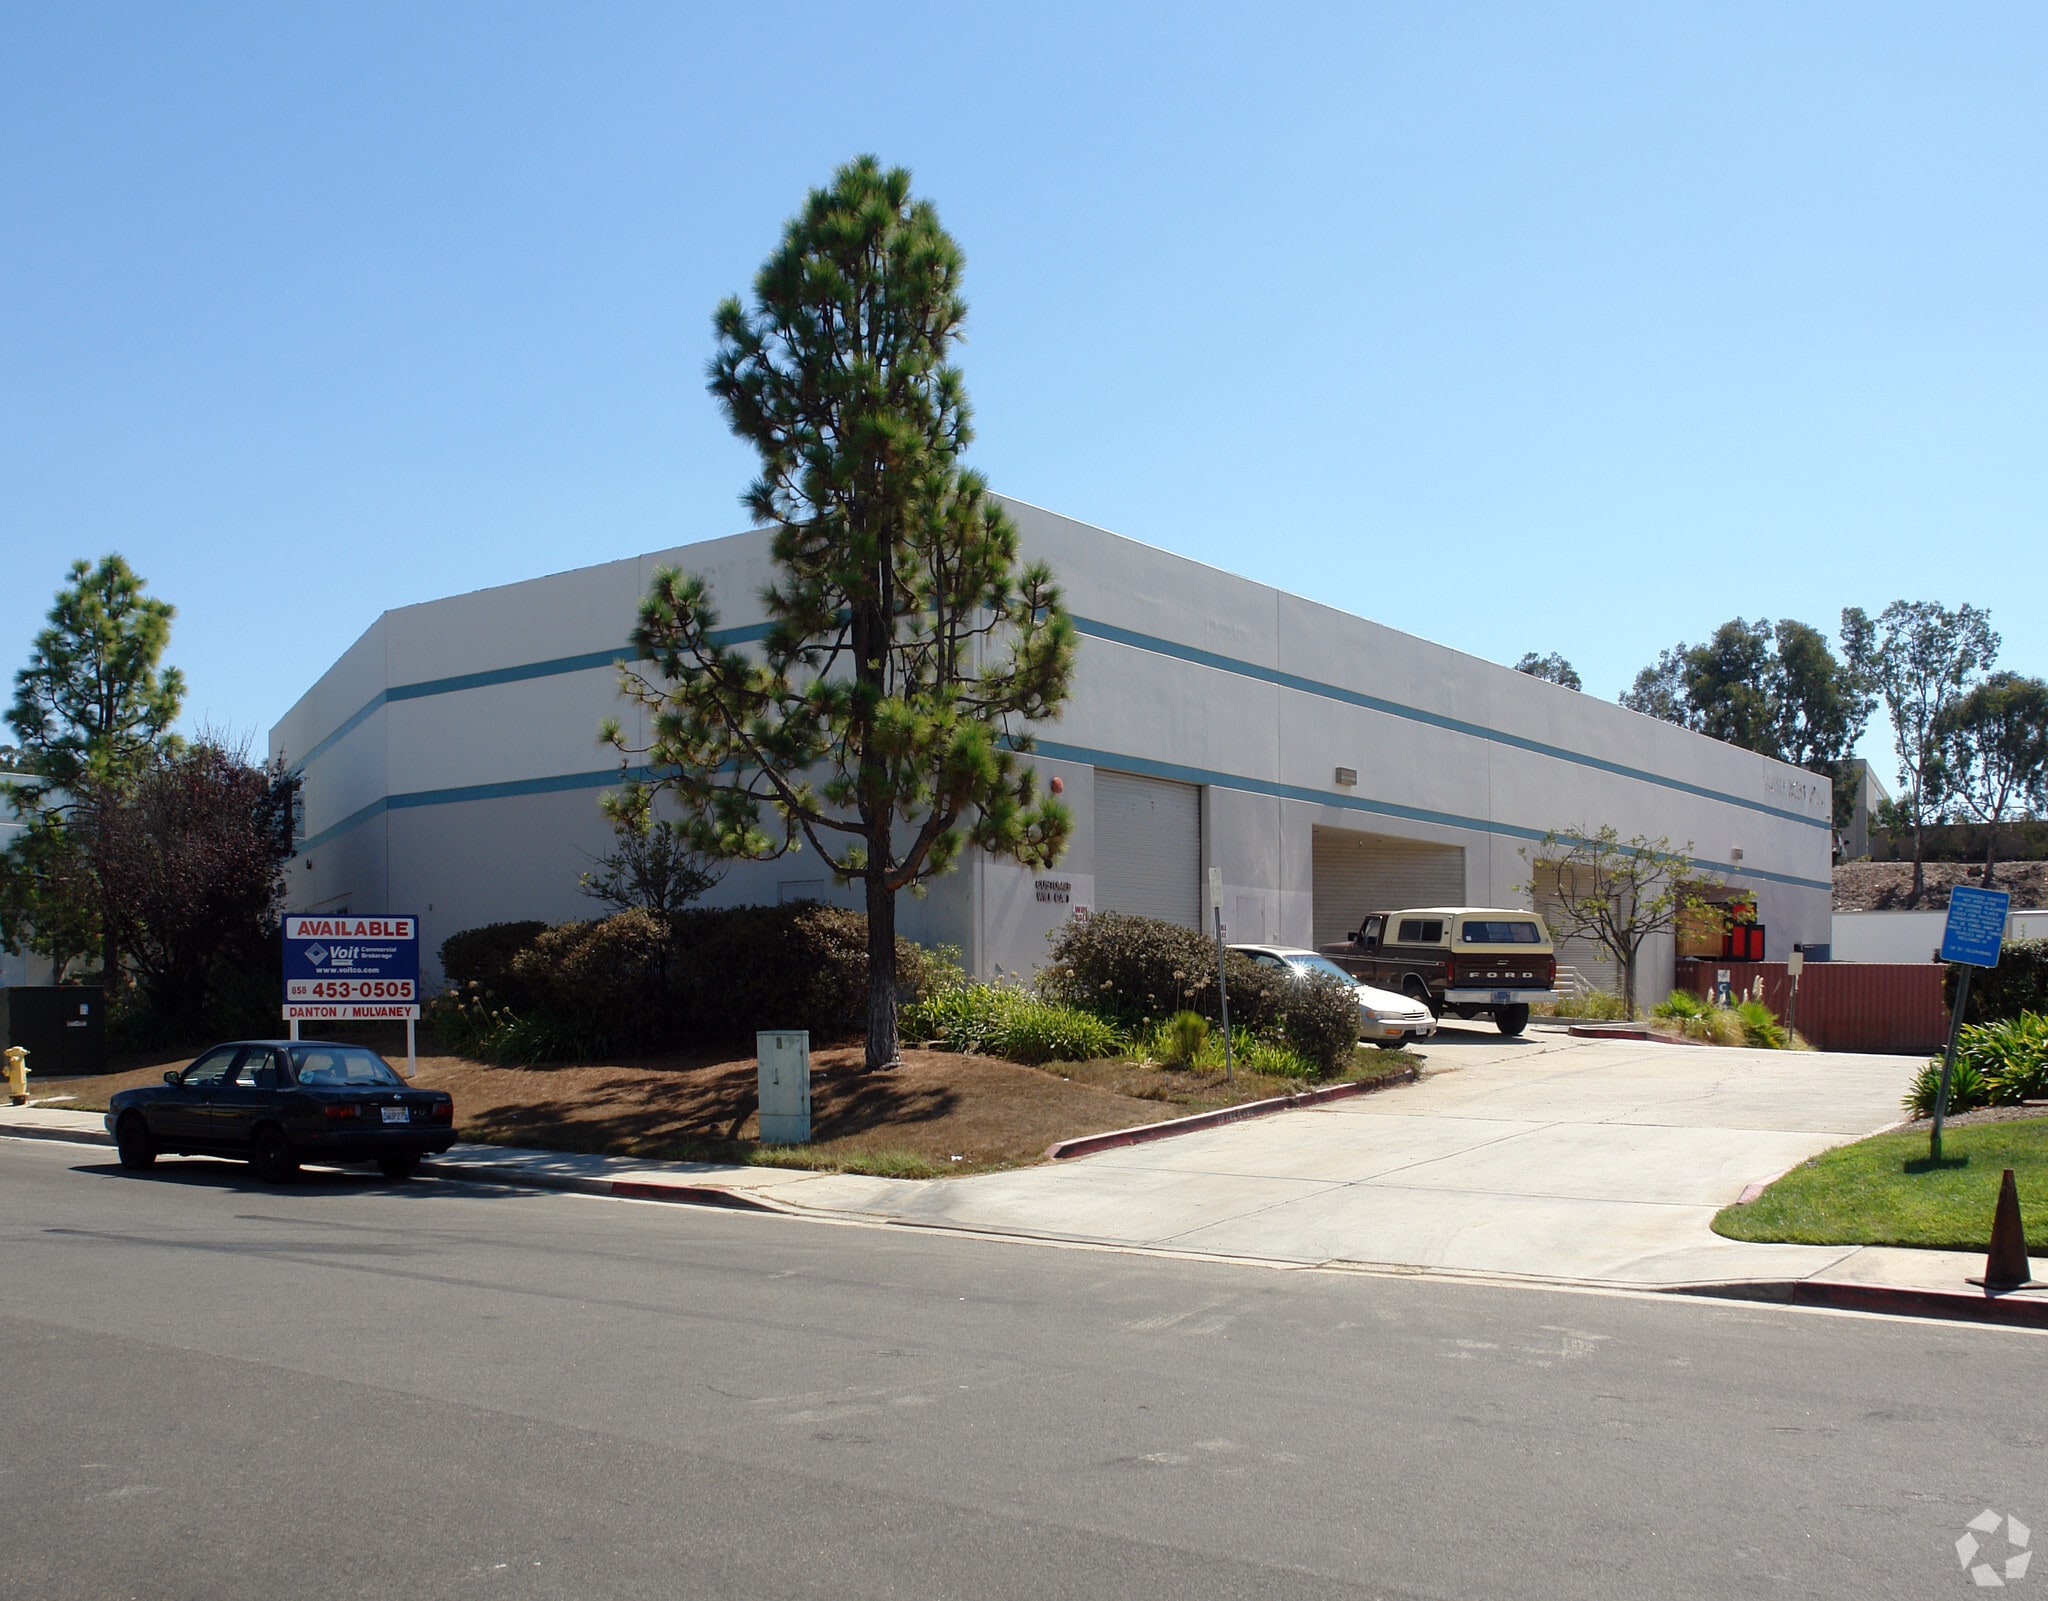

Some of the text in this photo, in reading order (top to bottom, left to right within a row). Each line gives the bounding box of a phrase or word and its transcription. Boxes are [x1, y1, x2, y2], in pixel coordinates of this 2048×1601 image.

[297, 921, 409, 937] AVAILABLE
[330, 946, 359, 959] Voit
[316, 966, 380, 974] www.voitco.com
[291, 982, 412, 998] 858 453-0505
[289, 1007, 337, 1017] DANTON
[352, 1007, 412, 1017] MULVANEY
